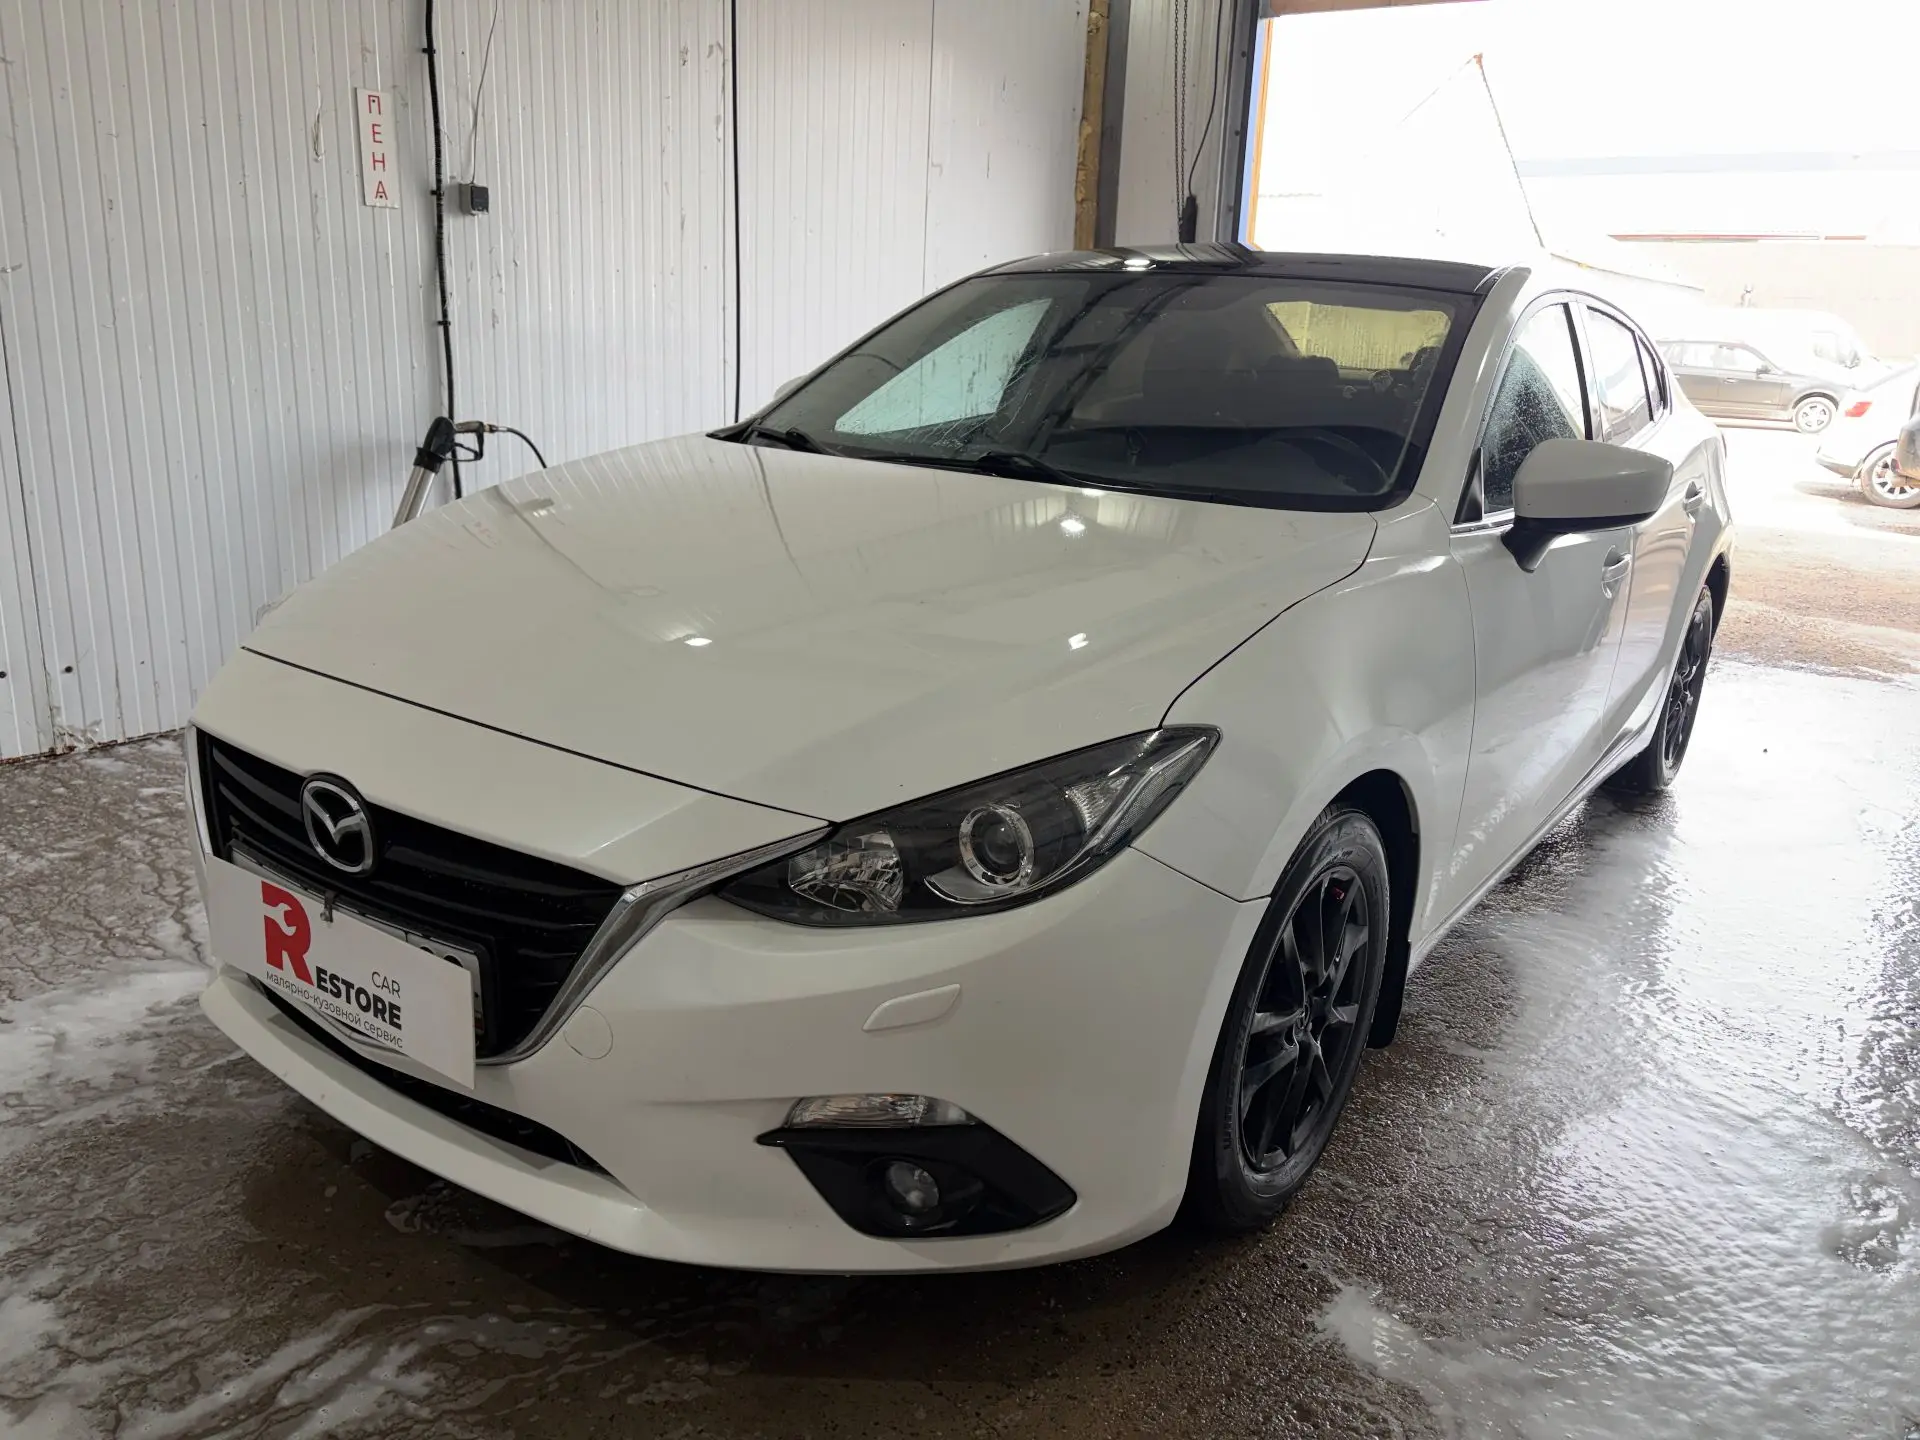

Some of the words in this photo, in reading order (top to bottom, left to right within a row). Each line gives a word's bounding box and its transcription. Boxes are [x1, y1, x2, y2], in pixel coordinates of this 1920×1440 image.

[367, 94, 388, 201] ПЕНА
[266, 971, 362, 1027] малярно-кузовной
[363, 1018, 403, 1048] сервис
[371, 971, 401, 999] CAR
